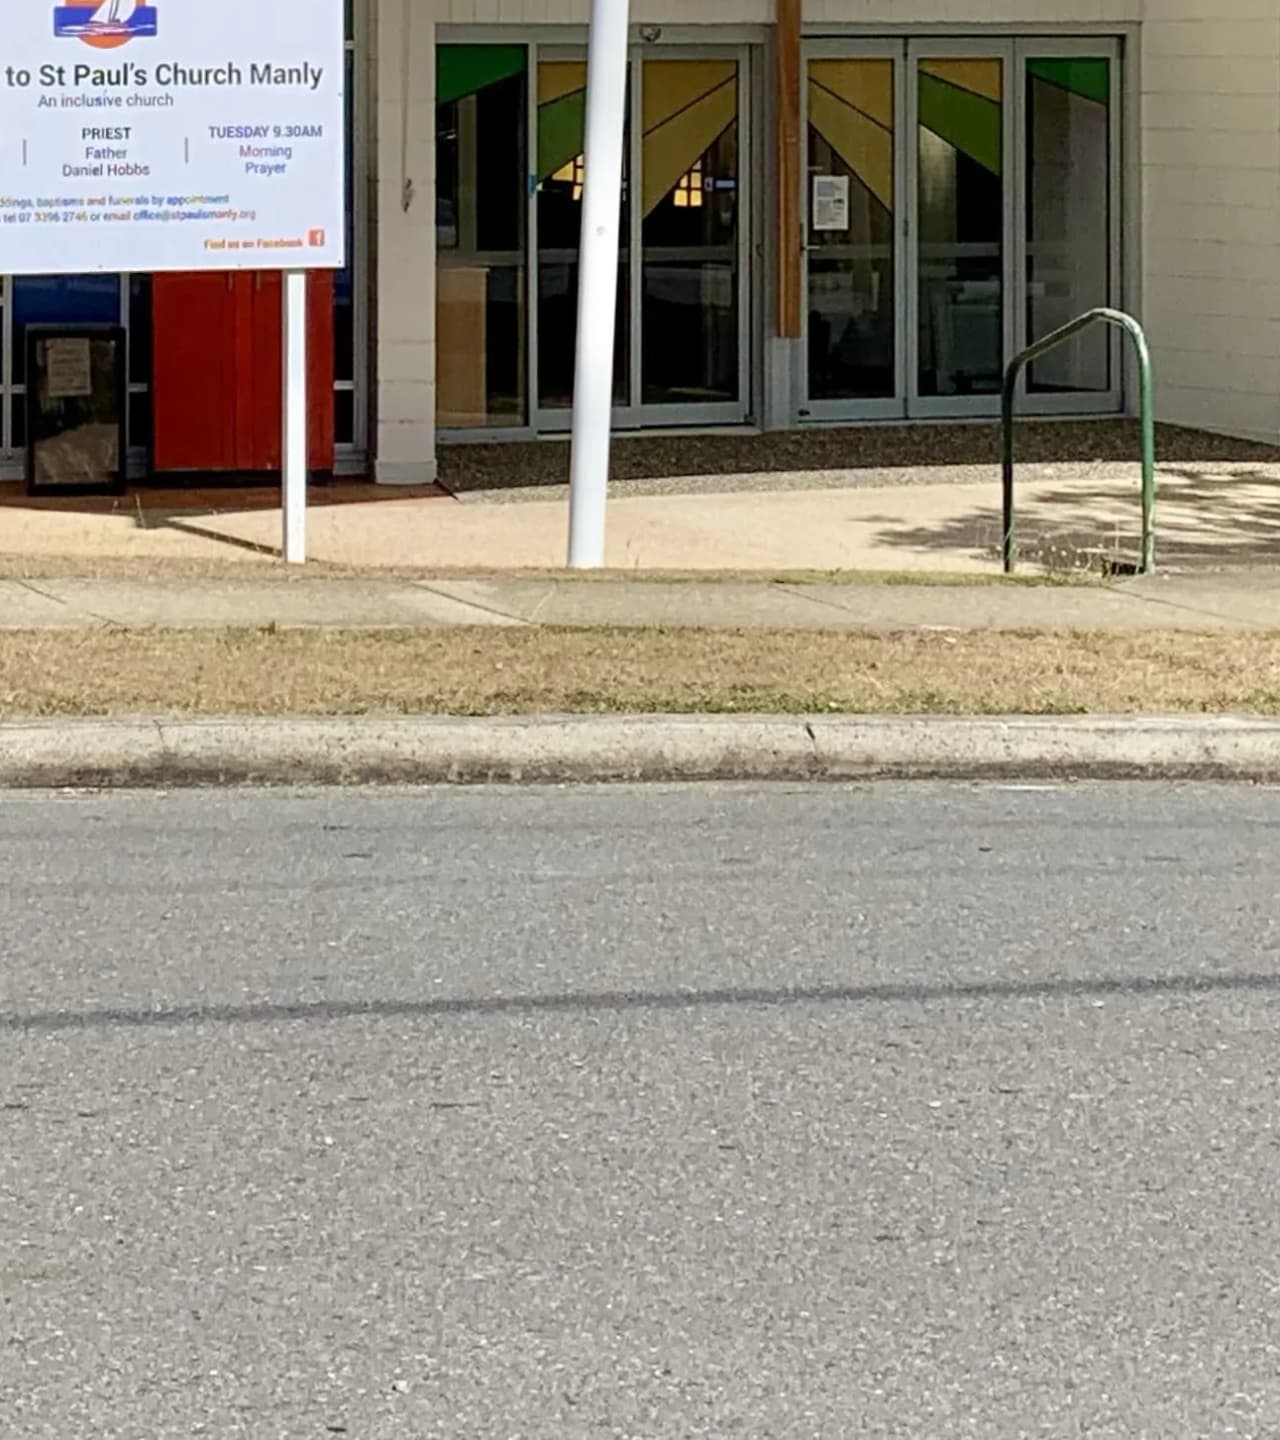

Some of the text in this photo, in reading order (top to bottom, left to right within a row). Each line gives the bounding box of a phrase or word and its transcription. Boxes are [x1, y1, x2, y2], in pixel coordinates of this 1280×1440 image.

[6, 67, 30, 87] to
[40, 64, 66, 86] St
[74, 62, 147, 86] Paul's
[155, 62, 241, 86] Church
[251, 62, 322, 90] Manly
[38, 93, 173, 107] An inclusive church
[82, 127, 132, 140] PRIEST
[208, 125, 322, 138] TUESDAY 9.30AM
[86, 147, 127, 159] Father
[240, 145, 292, 160] Morning
[63, 163, 150, 177] Daniel Hobbs
[245, 161, 286, 176] Prayer
[87, 196, 105, 207] and
[109, 194, 149, 206] funerals
[151, 195, 164, 208] by
[166, 194, 229, 207] appointment
[90, 212, 100, 222] or
[103, 210, 130, 222] email
